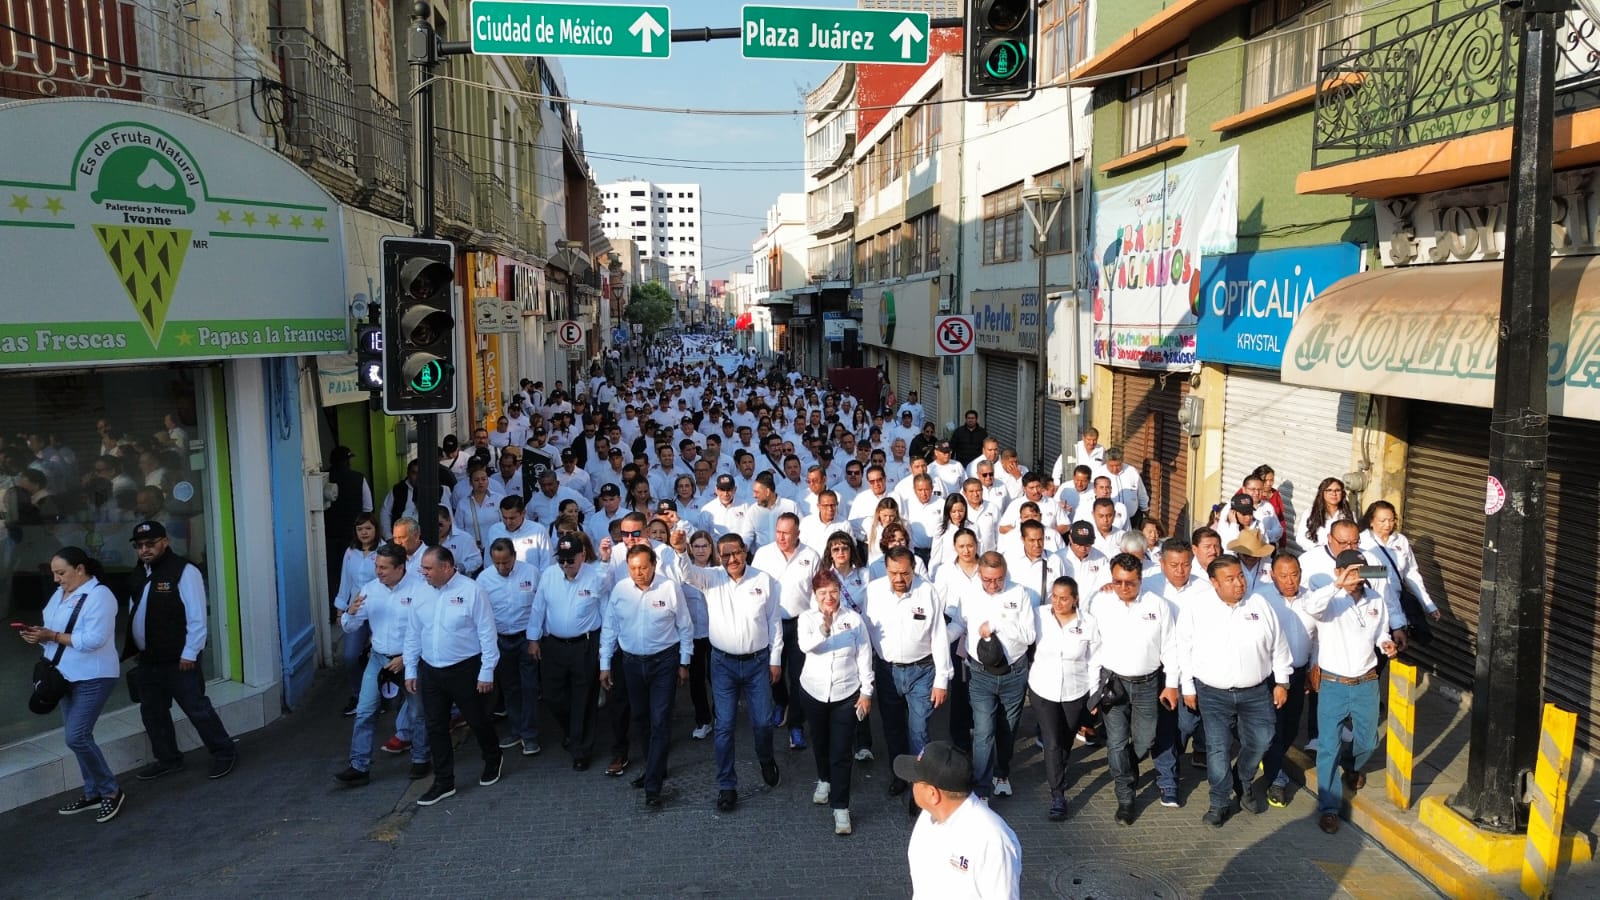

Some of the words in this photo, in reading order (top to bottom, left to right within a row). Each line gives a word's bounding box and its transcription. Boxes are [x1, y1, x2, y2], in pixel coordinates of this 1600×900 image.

[476, 14, 531, 43] Ciudad
[535, 15, 554, 43] de
[559, 18, 613, 46] México
[746, 18, 799, 48] Plaza
[808, 22, 875, 51] Juárez
[80, 156, 97, 176] Es
[94, 140, 112, 157] de
[111, 131, 151, 145] Fruta
[155, 137, 199, 186] Natural
[123, 212, 172, 226] Ivonne
[193, 240, 208, 249] MR
[984, 303, 1011, 332] Perla
[35, 330, 126, 351] Frescas
[198, 327, 249, 349] Papas
[252, 331, 263, 344] a
[265, 326, 281, 343] la
[283, 325, 346, 343] francesa
[566, 326, 575, 340] E
[1237, 333, 1281, 353] KRYSTAL
[1335, 311, 1498, 378] JOYERI
[487, 351, 497, 423] PASTES
[959, 855, 969, 869] 15
